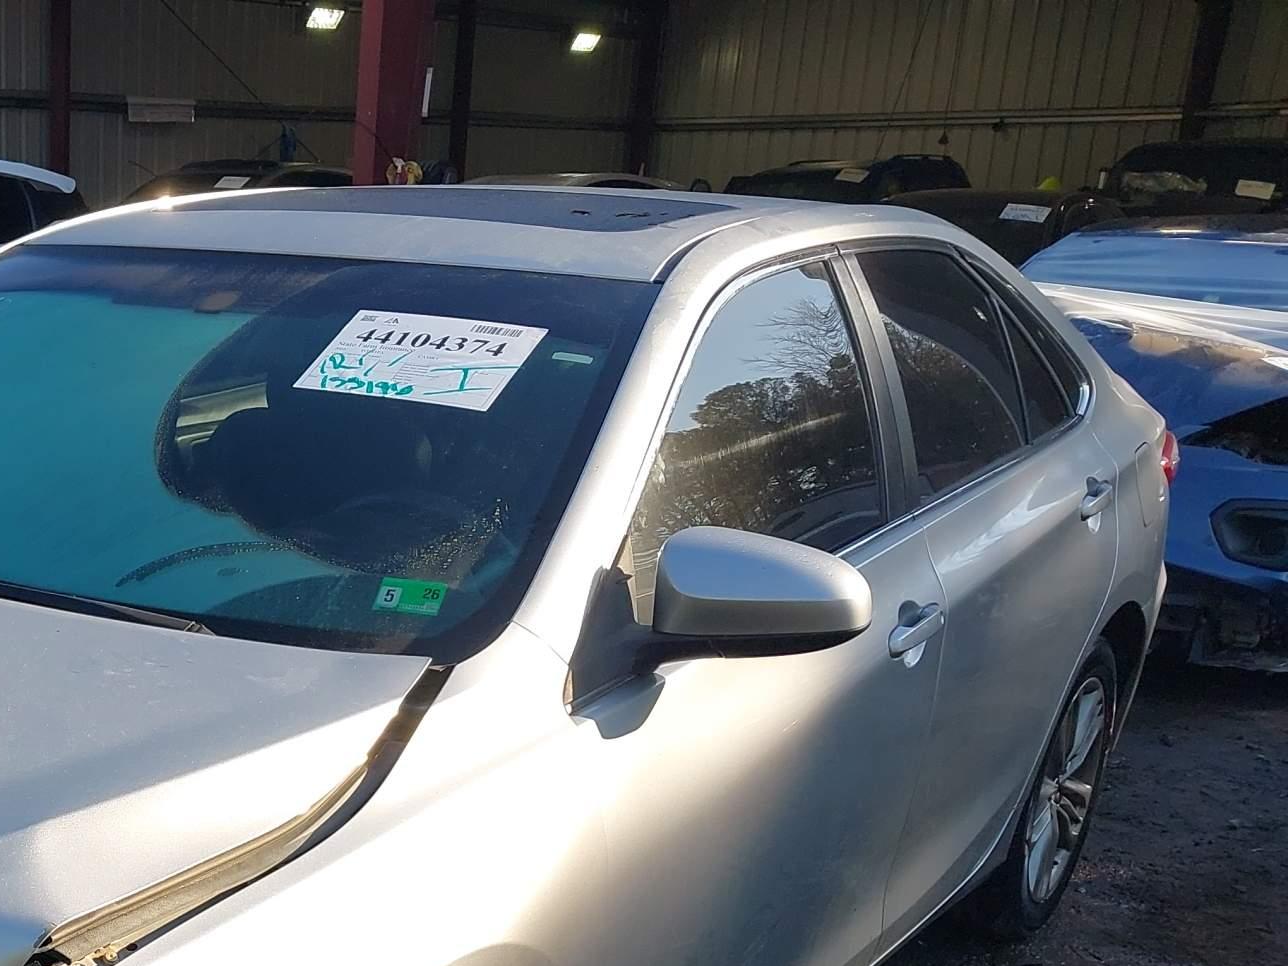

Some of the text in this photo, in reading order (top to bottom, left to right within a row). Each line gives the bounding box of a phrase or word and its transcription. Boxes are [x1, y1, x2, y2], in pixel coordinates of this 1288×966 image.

[356, 328, 508, 357] 44104374
[384, 588, 441, 602] 5 26
